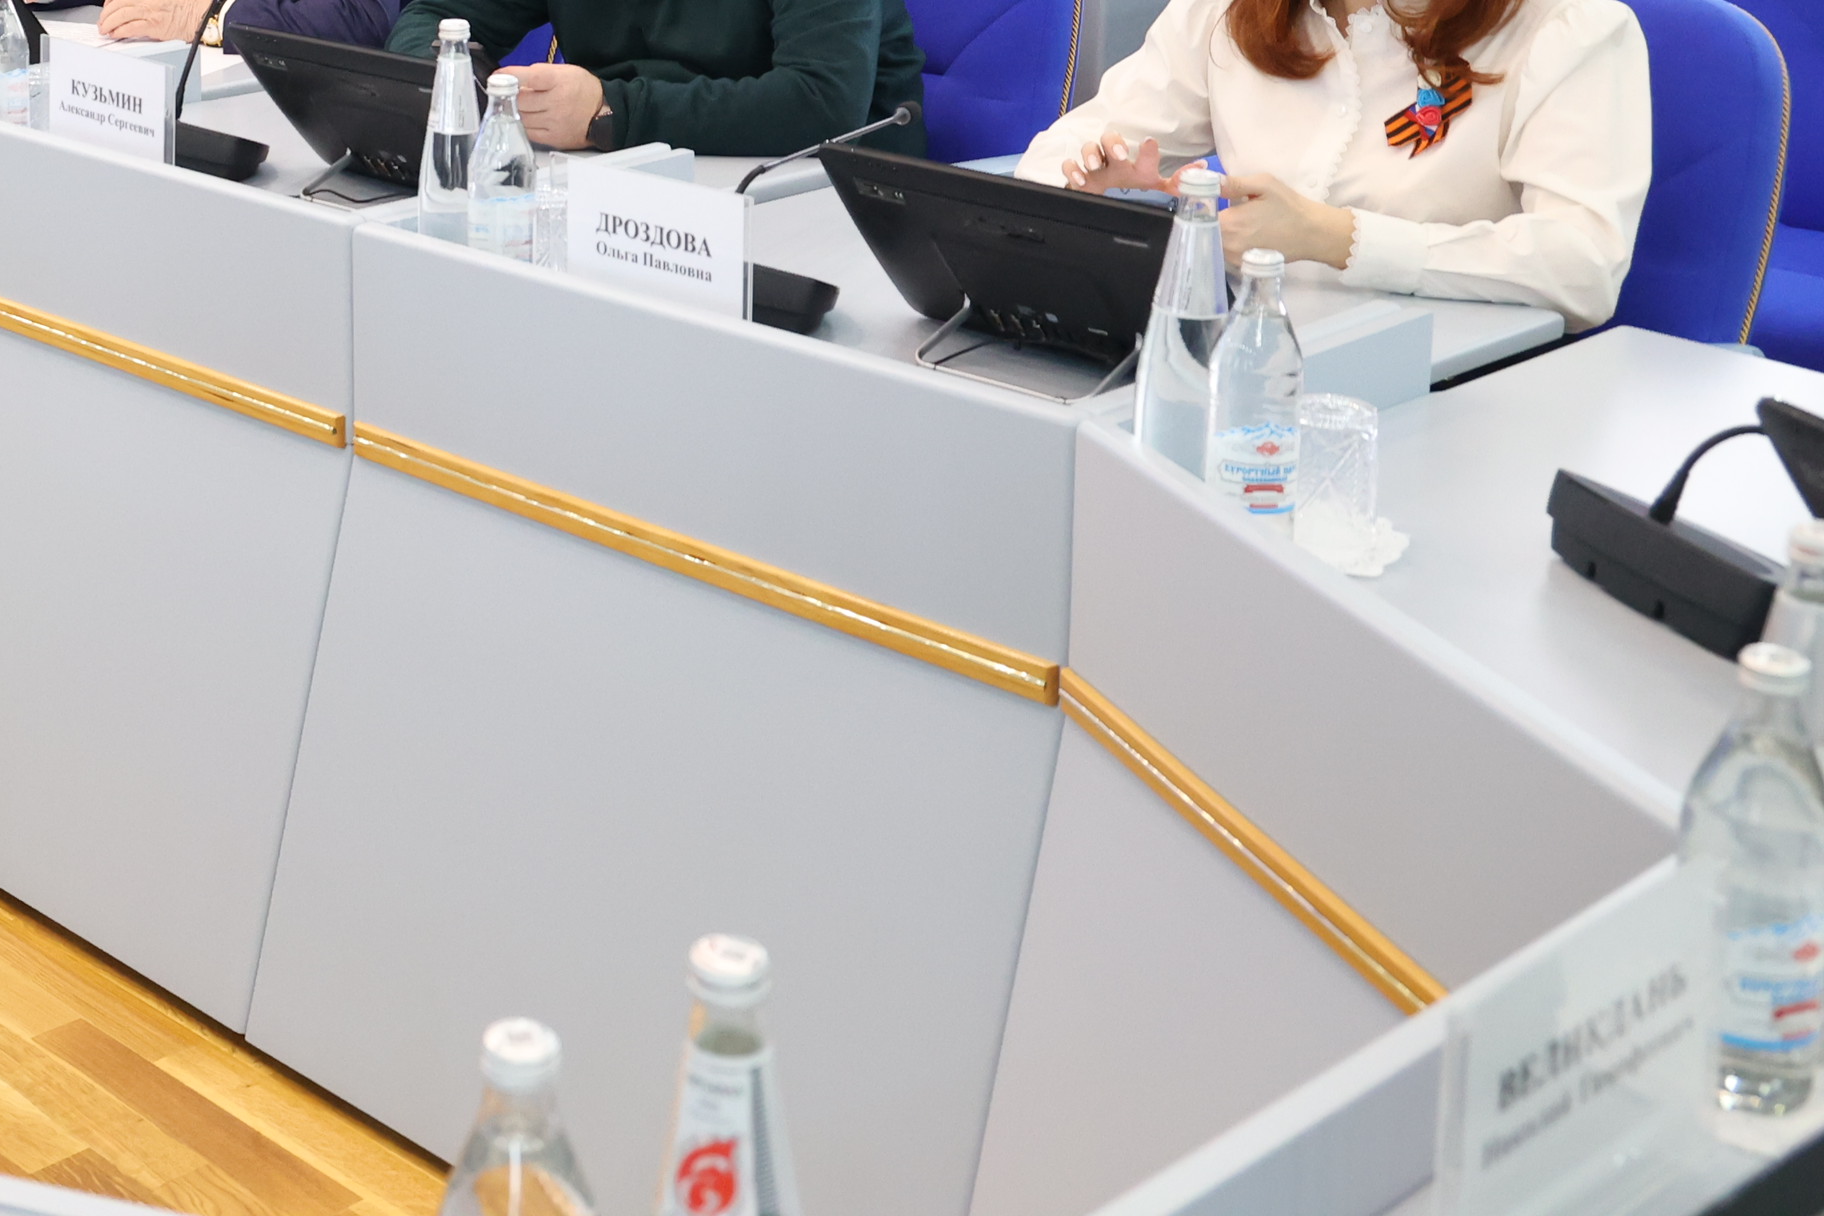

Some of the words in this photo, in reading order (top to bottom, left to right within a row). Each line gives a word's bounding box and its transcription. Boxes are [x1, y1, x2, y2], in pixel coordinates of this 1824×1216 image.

[71, 78, 142, 114] КУЗЬМИН
[58, 100, 106, 125] Александр
[107, 113, 156, 138] Сергеевич
[595, 211, 713, 259] ДРОЗДОВА
[596, 240, 638, 264] Ольга
[642, 251, 712, 283] Павловна
